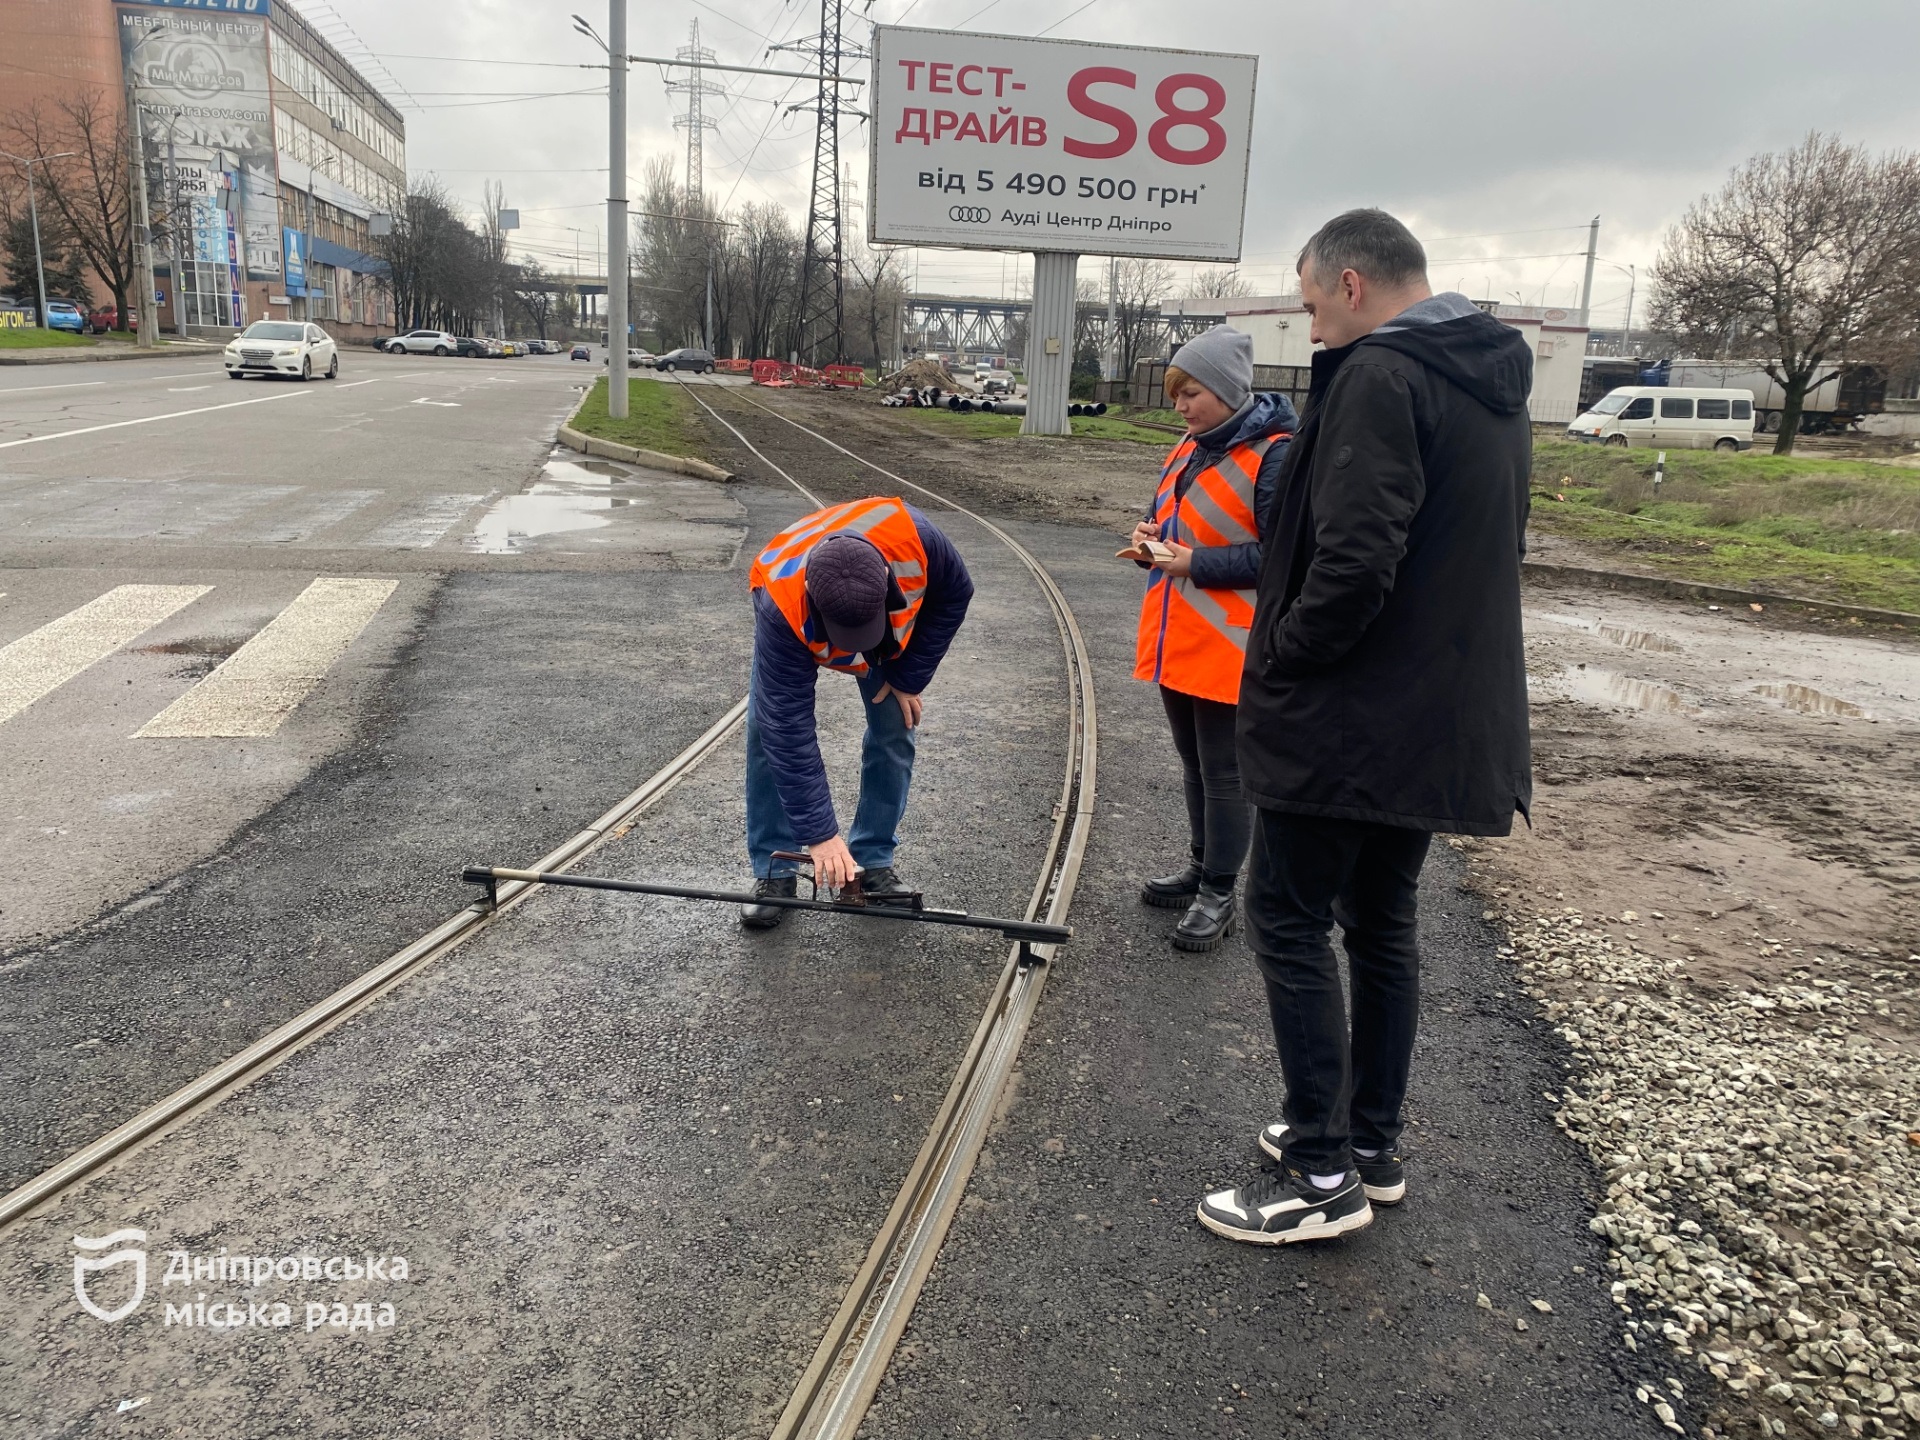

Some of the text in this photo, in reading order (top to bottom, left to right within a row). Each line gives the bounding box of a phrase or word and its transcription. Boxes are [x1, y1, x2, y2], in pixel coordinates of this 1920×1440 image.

[122, 14, 260, 36] МЕБЕЛЬНЫЙ ЦЕНТР
[898, 59, 1027, 98] ТЕСТ-
[895, 105, 1048, 147] ДРАЙВ
[1063, 66, 1227, 166] S8
[174, 122, 252, 149] ЭТАЖ
[918, 167, 966, 195] від
[975, 170, 994, 192] 5
[1005, 171, 1067, 196] 490
[1077, 176, 1137, 201] 500
[1001, 208, 1173, 234] Ауді Центр Дніпро
